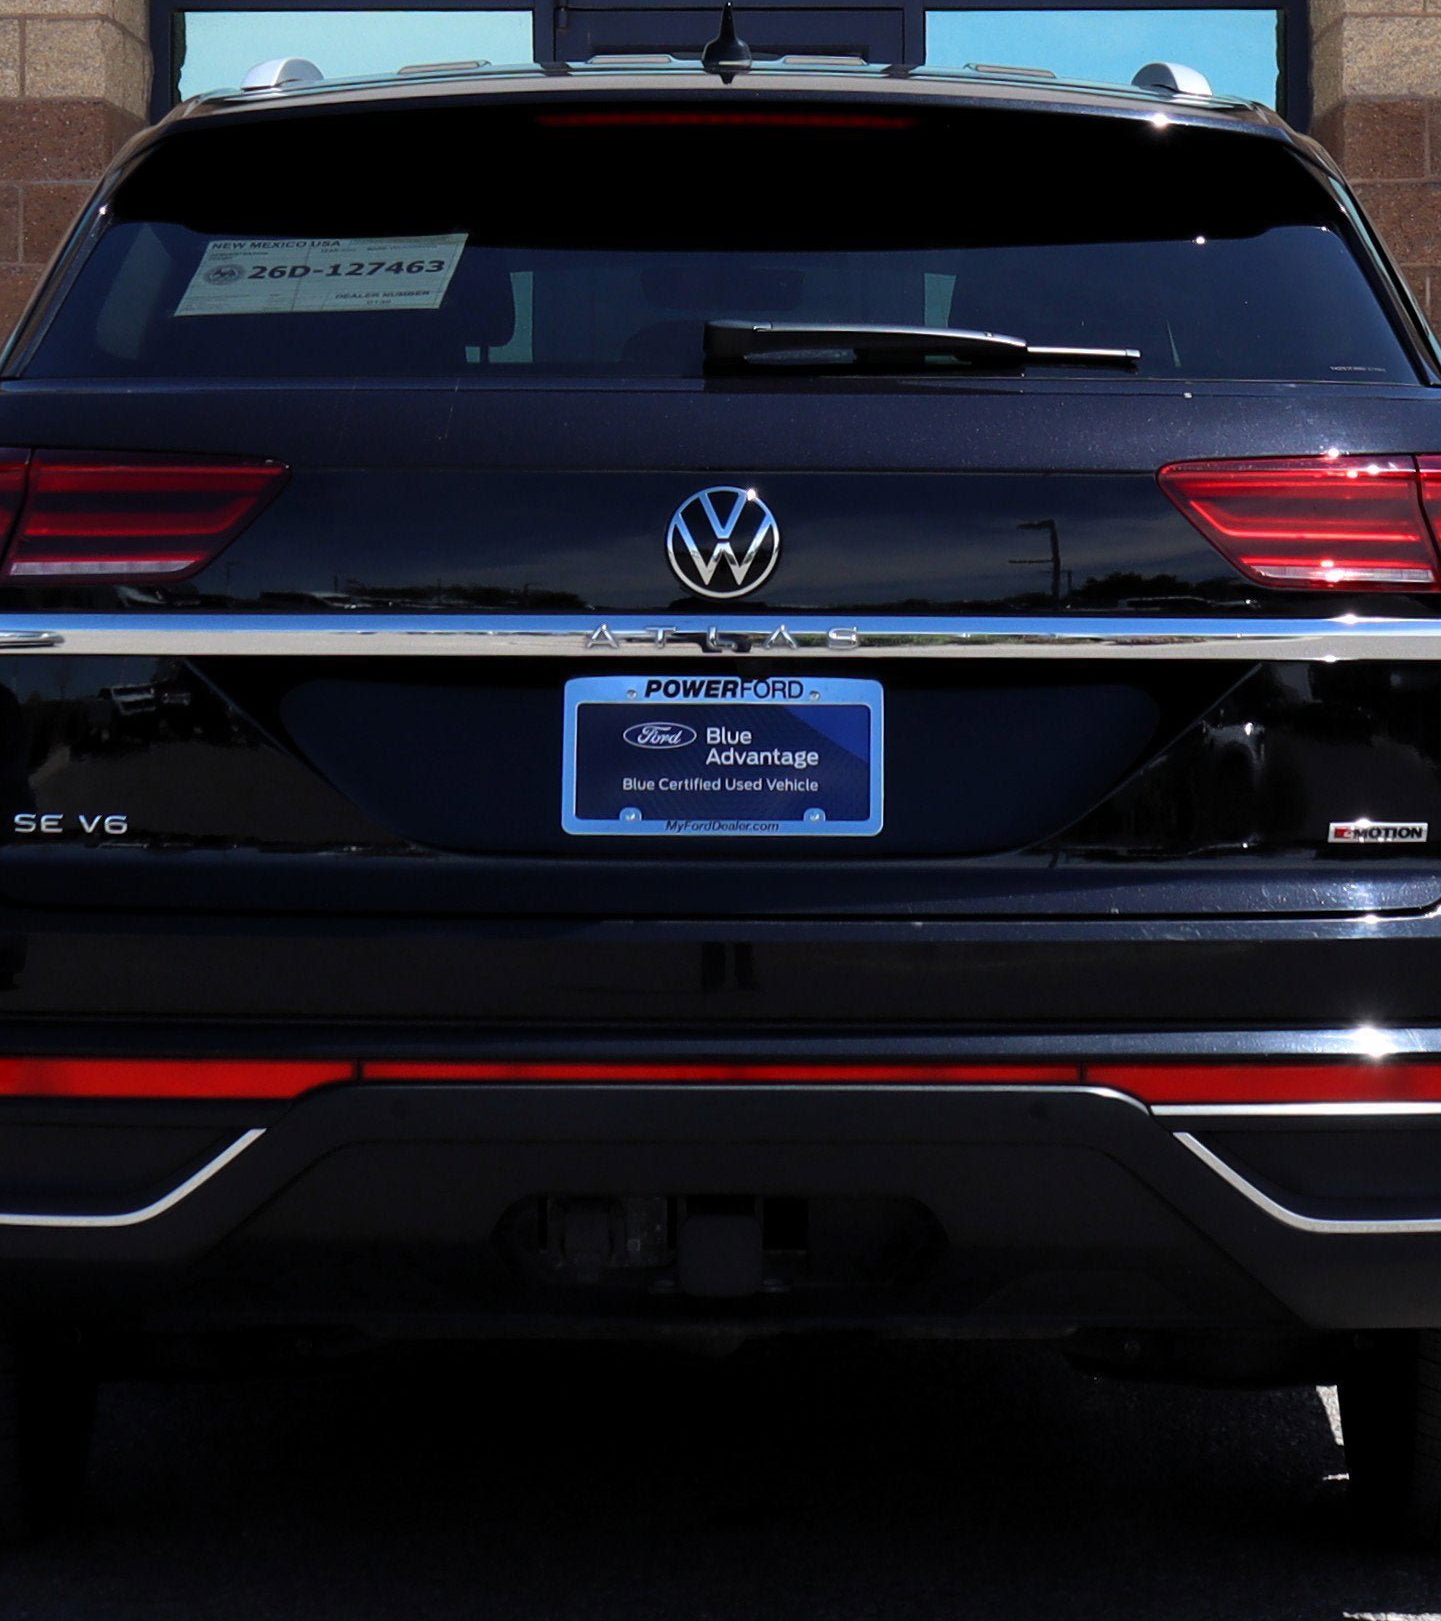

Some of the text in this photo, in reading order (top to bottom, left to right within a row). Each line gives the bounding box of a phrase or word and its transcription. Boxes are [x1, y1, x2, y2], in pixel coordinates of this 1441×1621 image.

[211, 239, 342, 250] NEW MEXICO USA
[247, 259, 446, 280] 26D-127463
[334, 290, 431, 300] DEALER NUMBER
[586, 623, 860, 650] ATLAS
[644, 679, 804, 700] POWERFORD
[636, 726, 683, 746] Ford
[706, 727, 752, 745] Blue
[706, 747, 819, 769] Advantage
[622, 777, 819, 792] Blue Certified Used Vehicle
[13, 813, 128, 835] SE V6
[664, 820, 780, 834] MyFordDealer.com
